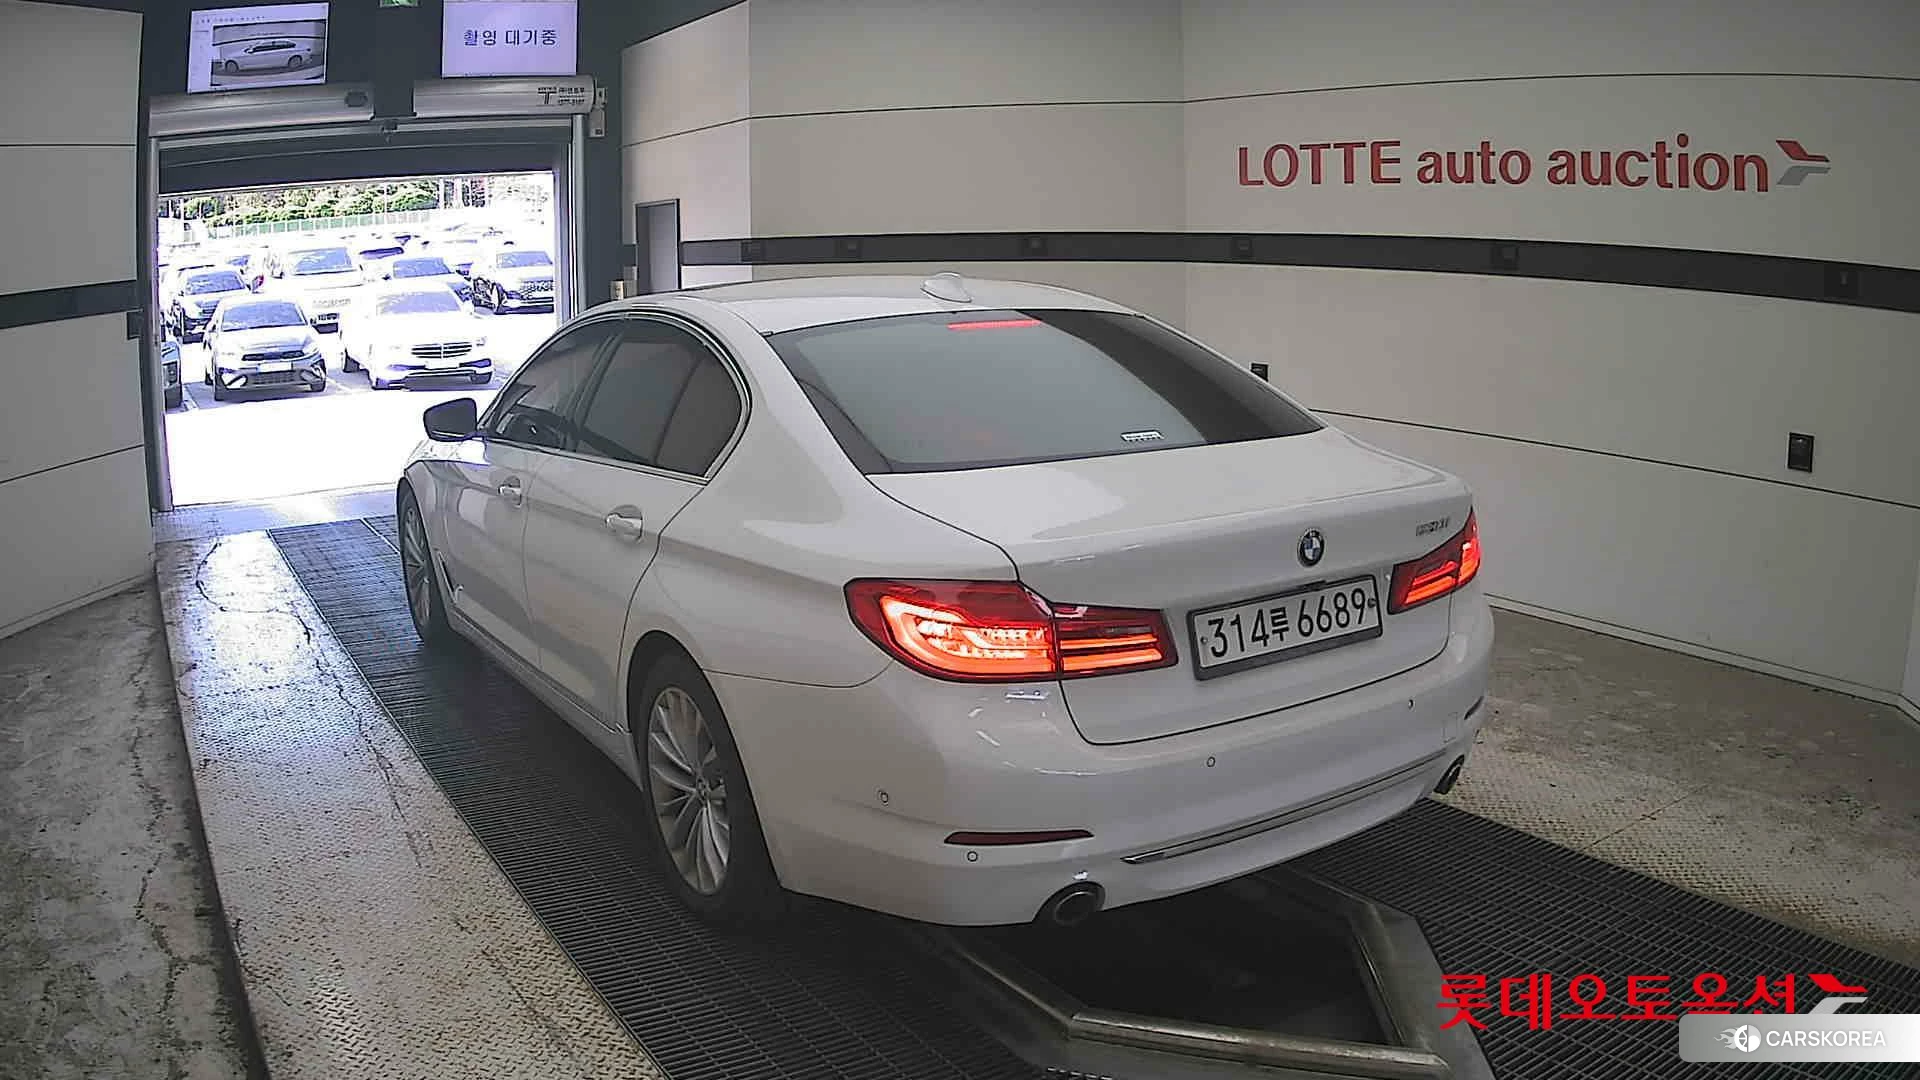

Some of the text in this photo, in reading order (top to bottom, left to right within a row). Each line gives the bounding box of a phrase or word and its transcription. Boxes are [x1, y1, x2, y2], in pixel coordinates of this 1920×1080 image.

[464, 29, 557, 46] 촬영 대기중
[1238, 133, 1769, 192] LOTTE auto auction
[1207, 588, 1366, 657] 314루 6689
